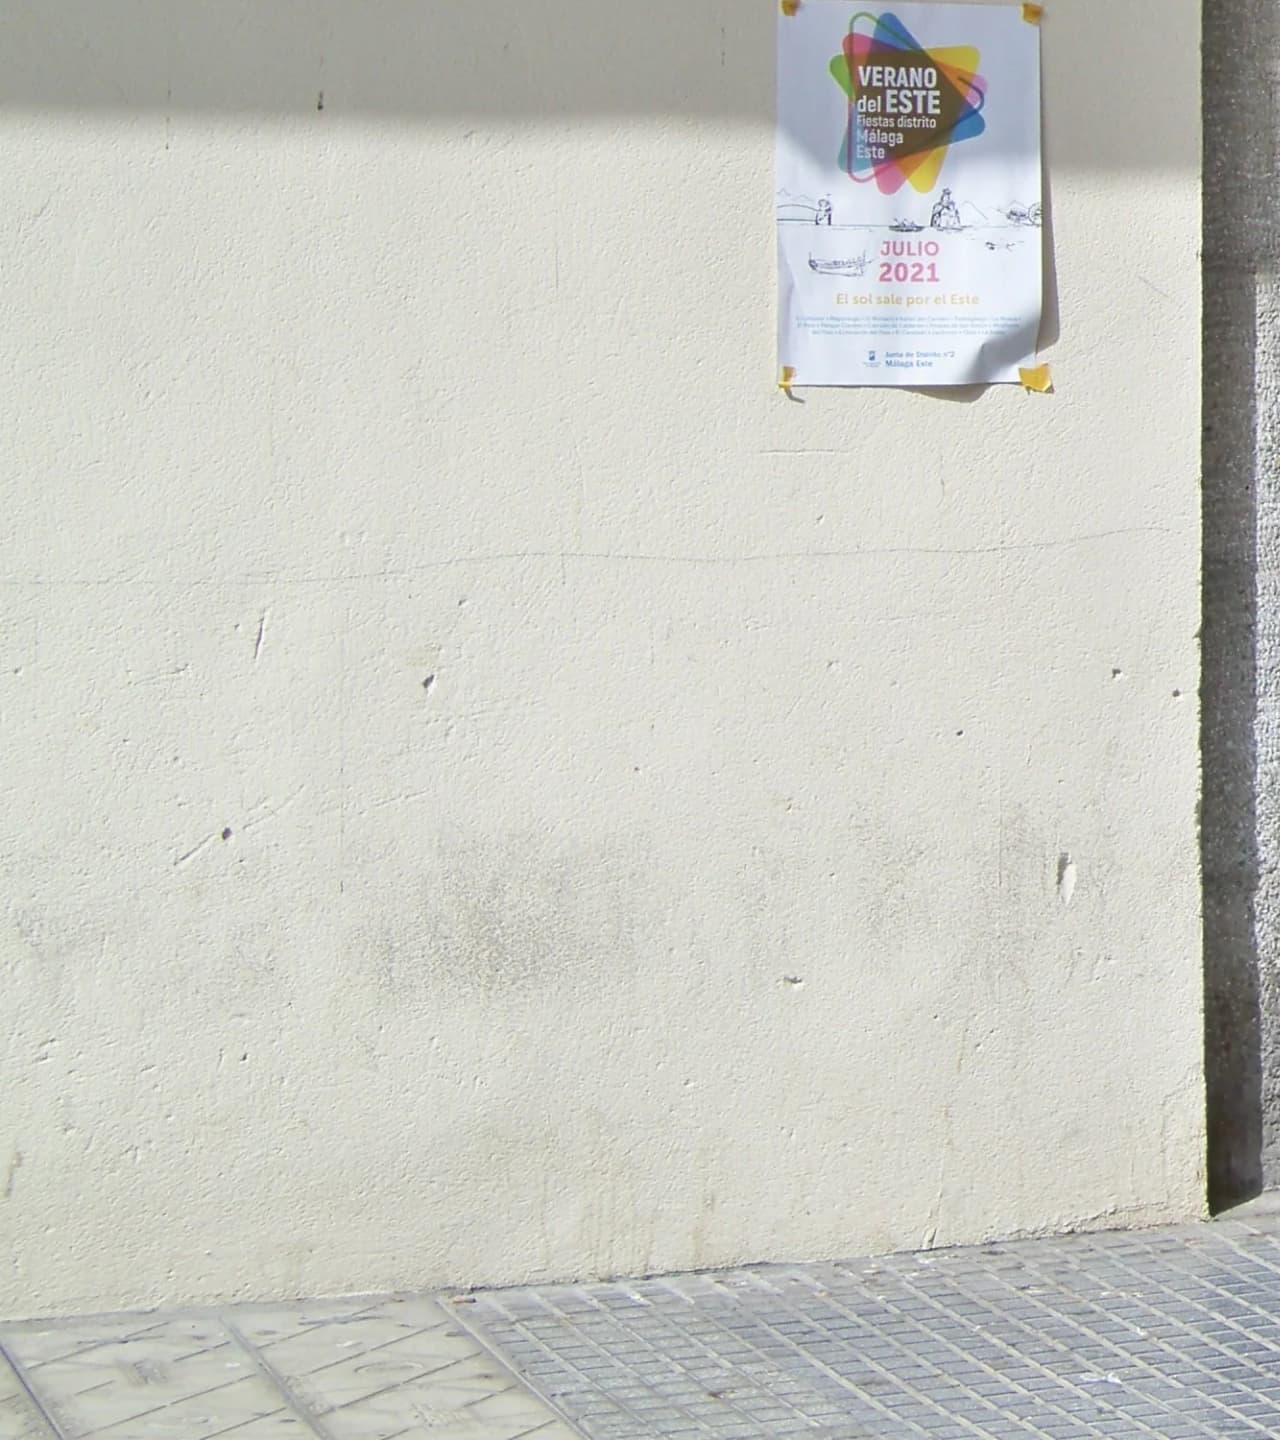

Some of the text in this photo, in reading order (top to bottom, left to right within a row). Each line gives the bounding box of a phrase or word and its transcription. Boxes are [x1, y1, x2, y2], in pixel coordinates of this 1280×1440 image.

[857, 65, 938, 88] VERANO
[857, 89, 941, 115] del ESTE
[856, 115, 937, 128] Fiestas distrito
[856, 128, 904, 147] Málaga
[856, 145, 885, 159] Este
[881, 240, 940, 258] JULIO
[879, 262, 941, 283] 2021
[836, 294, 980, 308] El sol sale por el Este
